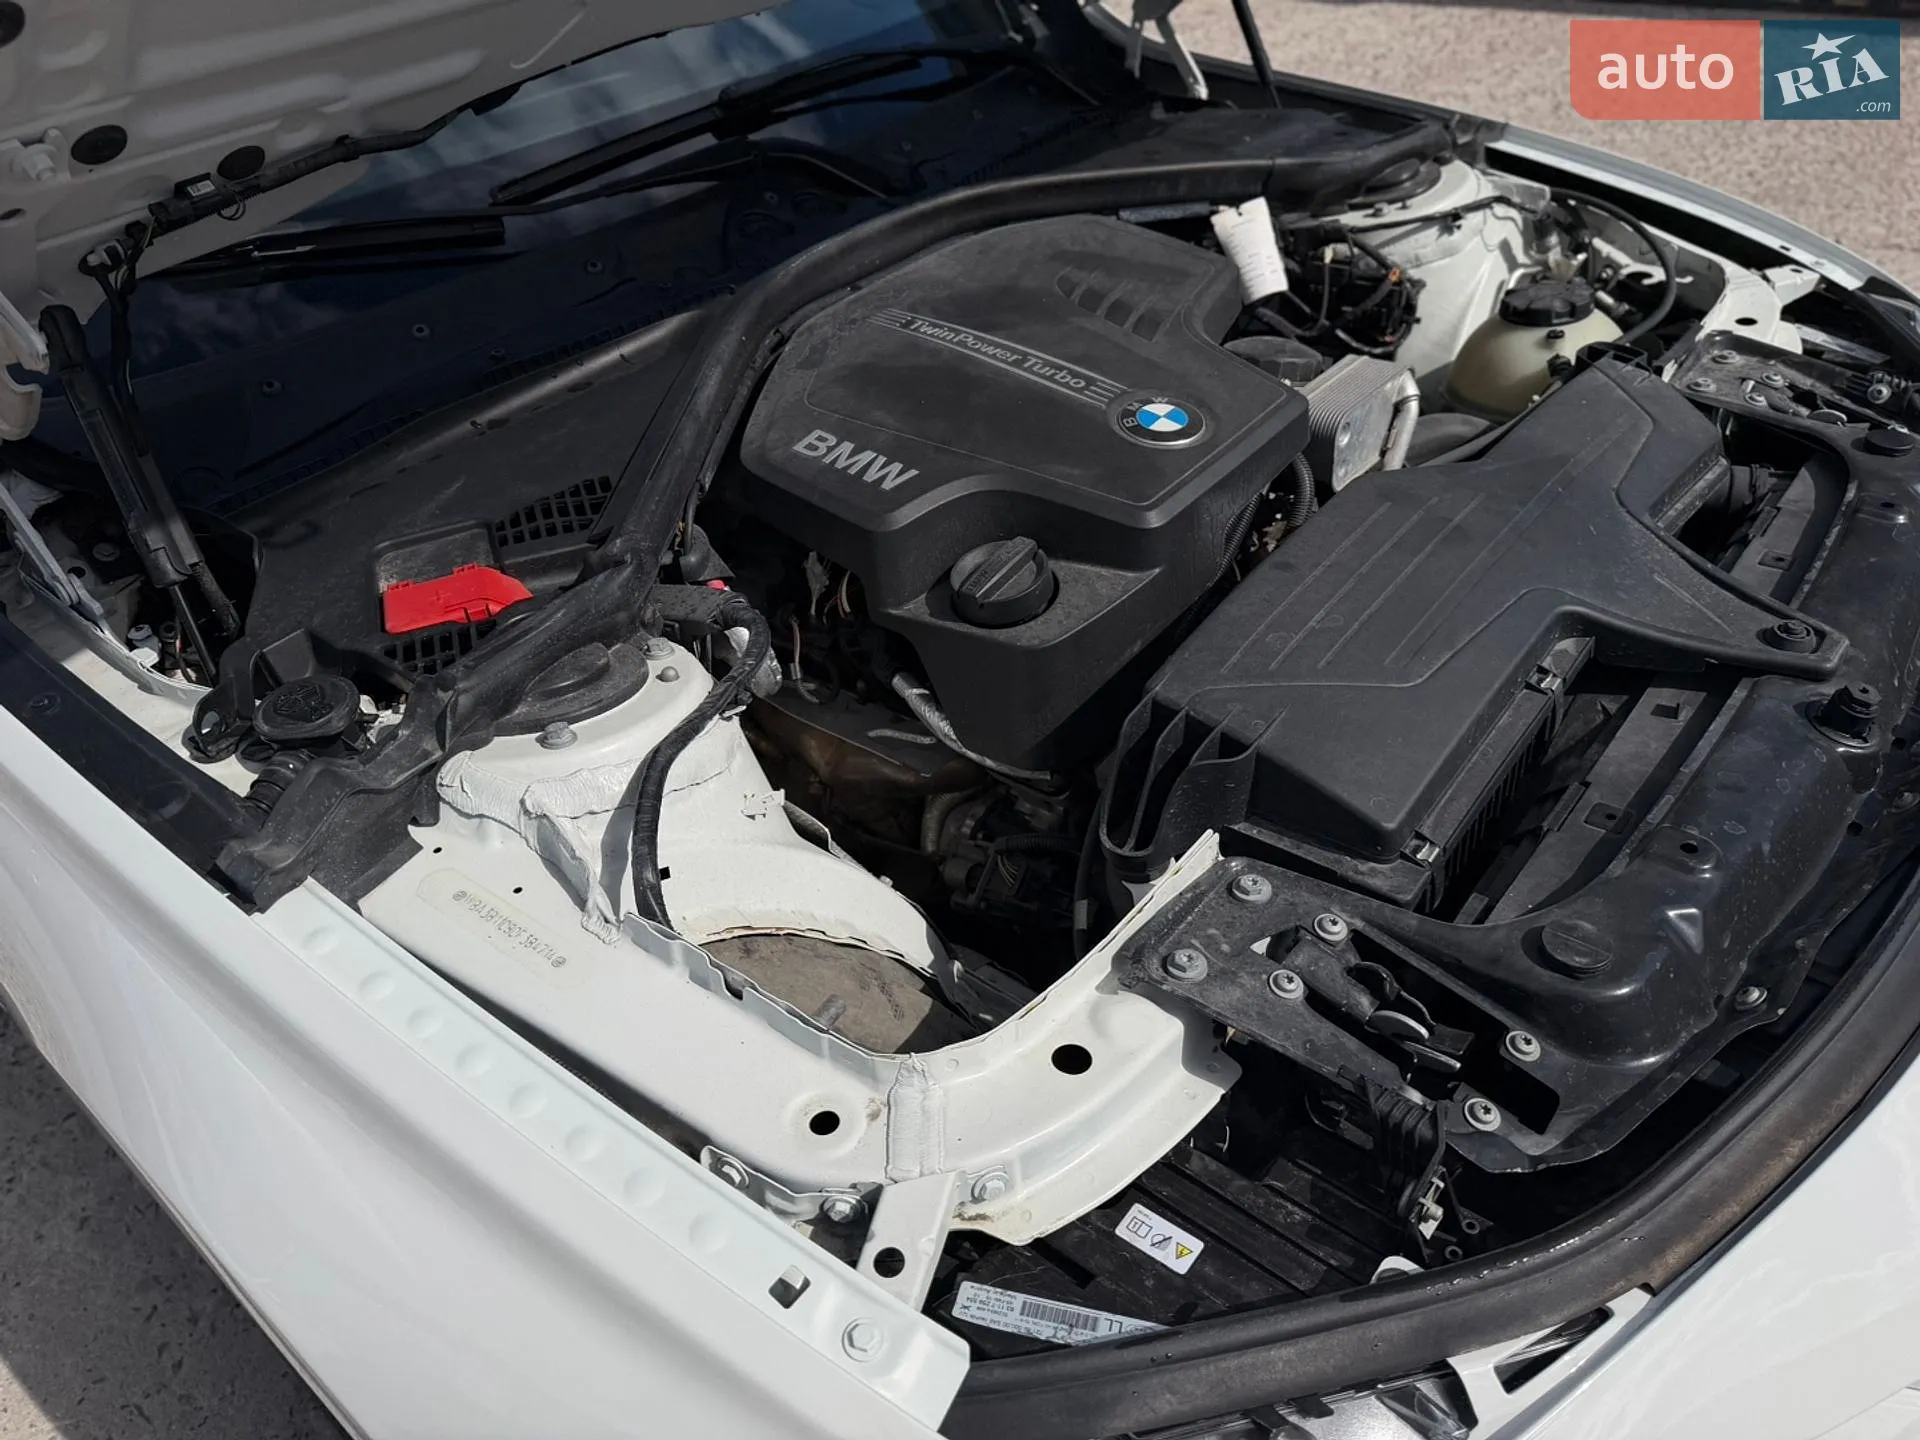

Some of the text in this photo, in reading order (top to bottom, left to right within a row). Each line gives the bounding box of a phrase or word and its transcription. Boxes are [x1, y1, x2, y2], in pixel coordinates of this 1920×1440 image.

[1023, 355, 1086, 388] Turbo
[1123, 397, 1168, 427] BMW
[792, 429, 920, 490] BMW
